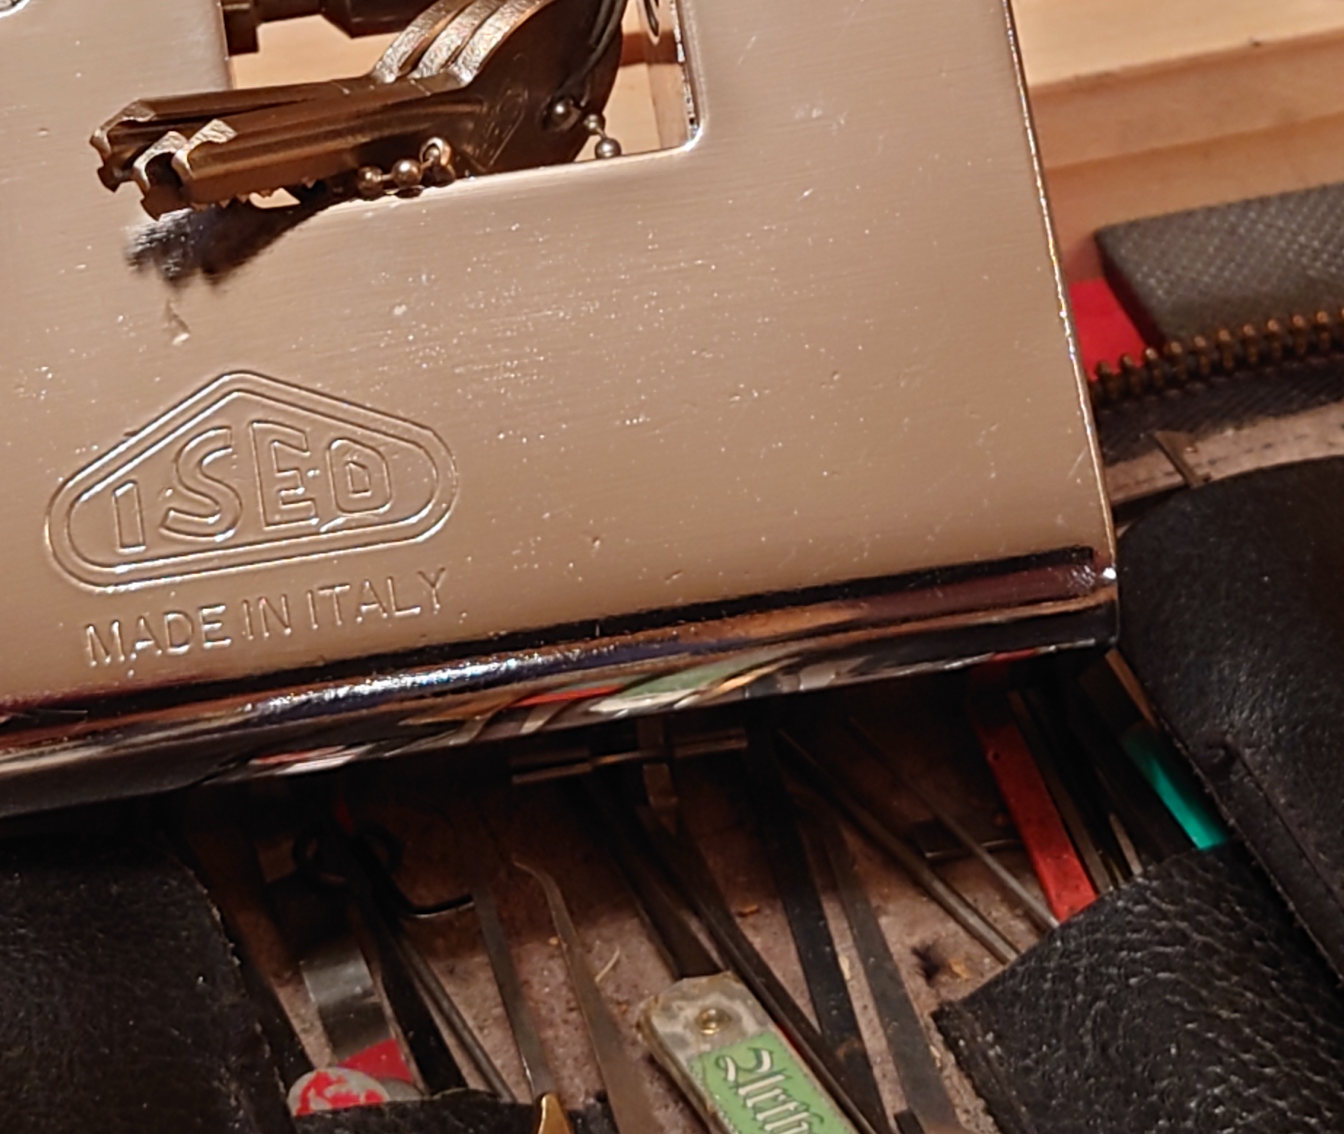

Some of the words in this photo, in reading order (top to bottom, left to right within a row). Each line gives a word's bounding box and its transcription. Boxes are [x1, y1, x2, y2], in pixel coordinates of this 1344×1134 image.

[113, 419, 393, 555] ISEO
[83, 603, 233, 667] MADE
[242, 594, 293, 640] IN
[306, 567, 447, 630] ITALY
